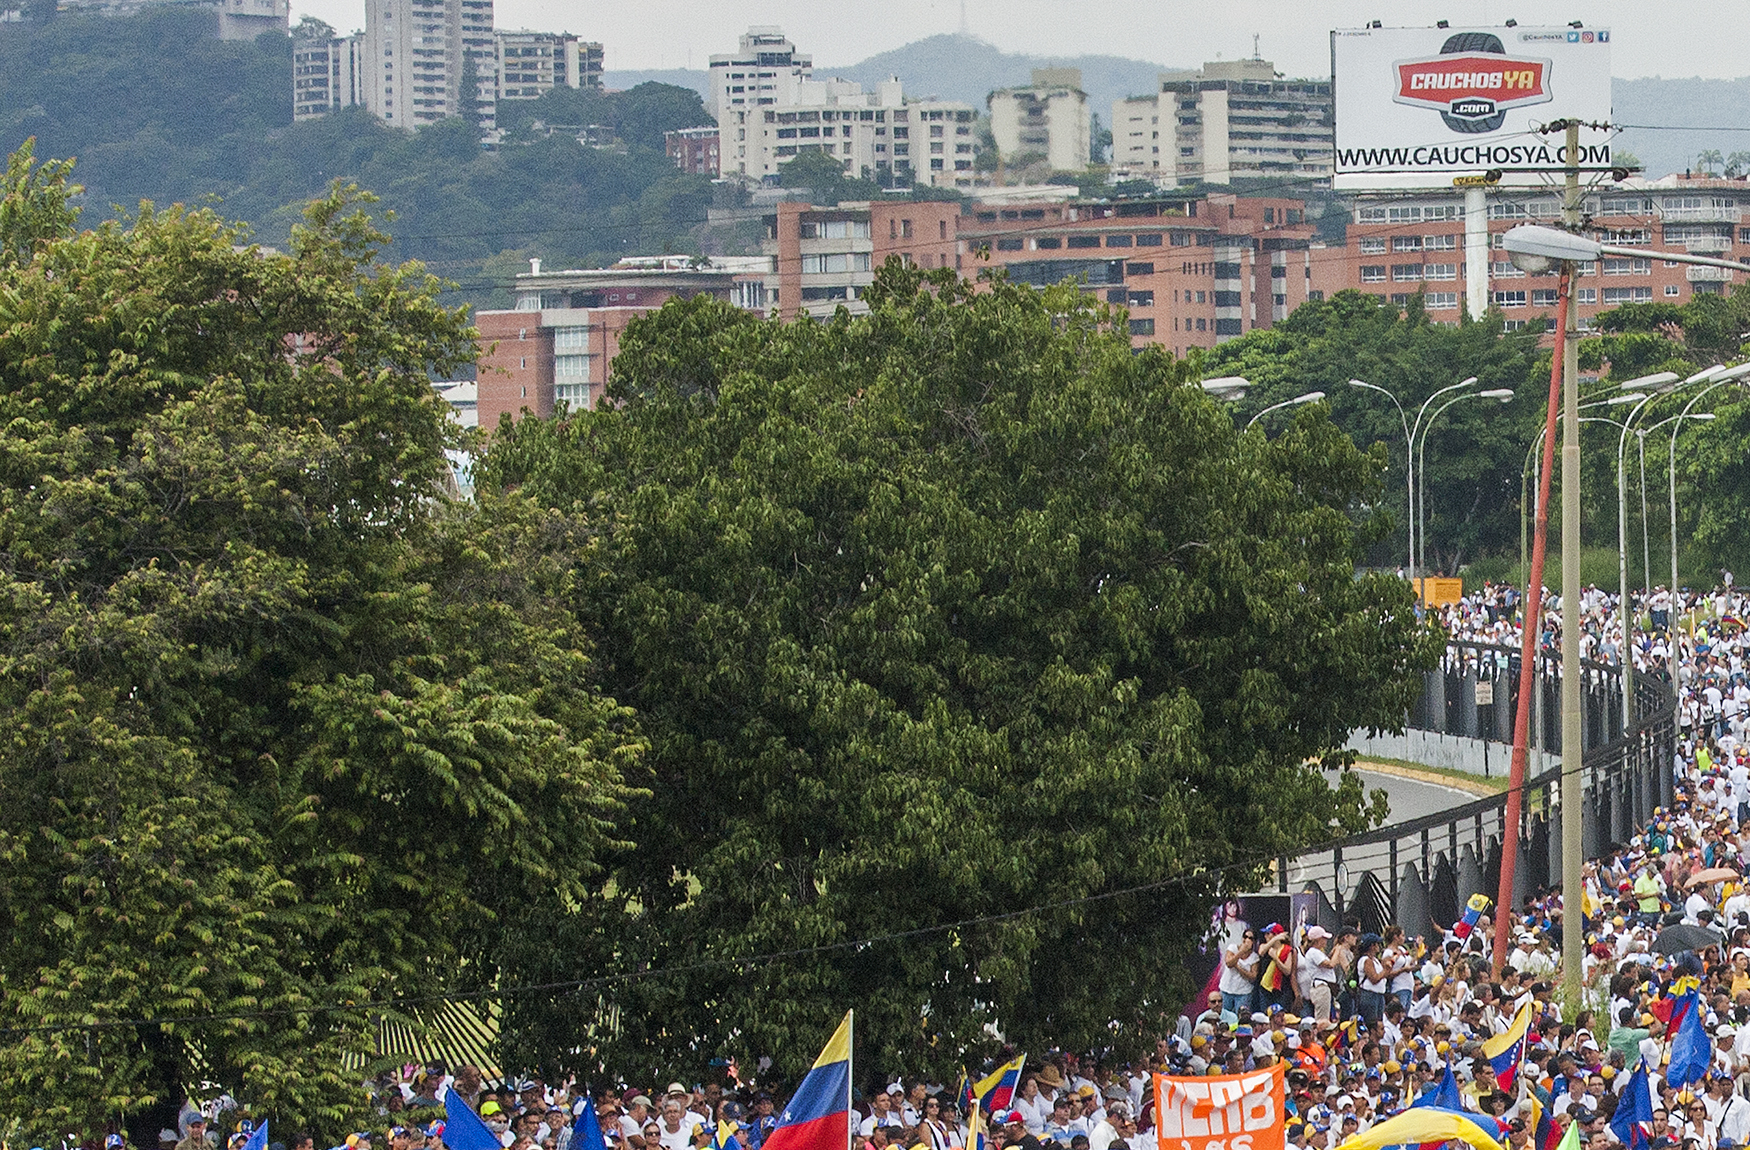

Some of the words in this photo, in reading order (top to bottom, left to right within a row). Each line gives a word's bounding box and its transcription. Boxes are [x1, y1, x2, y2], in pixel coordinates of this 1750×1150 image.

[1411, 70, 1535, 90] CAUCHOSYA
[1456, 103, 1490, 114] .com
[1337, 145, 1610, 167] WWW.CAUCHOSYA.COM
